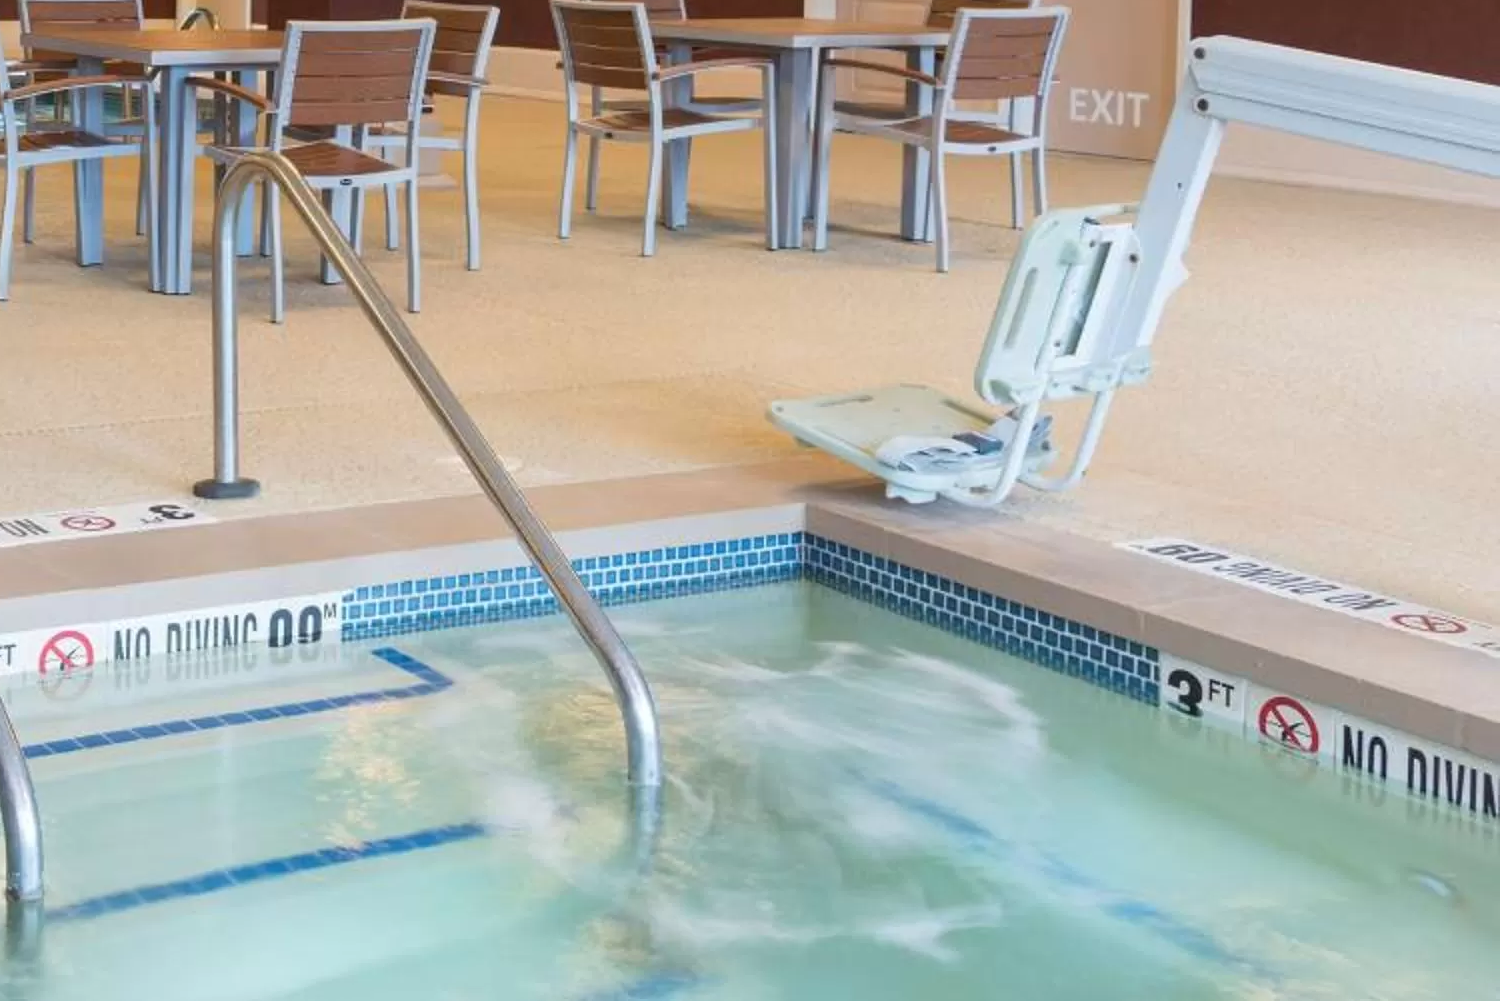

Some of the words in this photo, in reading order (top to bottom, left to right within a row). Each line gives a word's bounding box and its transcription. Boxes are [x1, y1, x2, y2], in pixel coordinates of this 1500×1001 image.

[1070, 87, 1150, 128] EXIT
[149, 504, 195, 520] 3
[1212, 562, 1342, 595] DIVING
[1324, 594, 1397, 610] NO
[114, 627, 150, 660] NO
[166, 612, 258, 653] DIVING
[1167, 668, 1204, 718] 3
[1208, 679, 1235, 708] FT
[1343, 724, 1387, 781] NO
